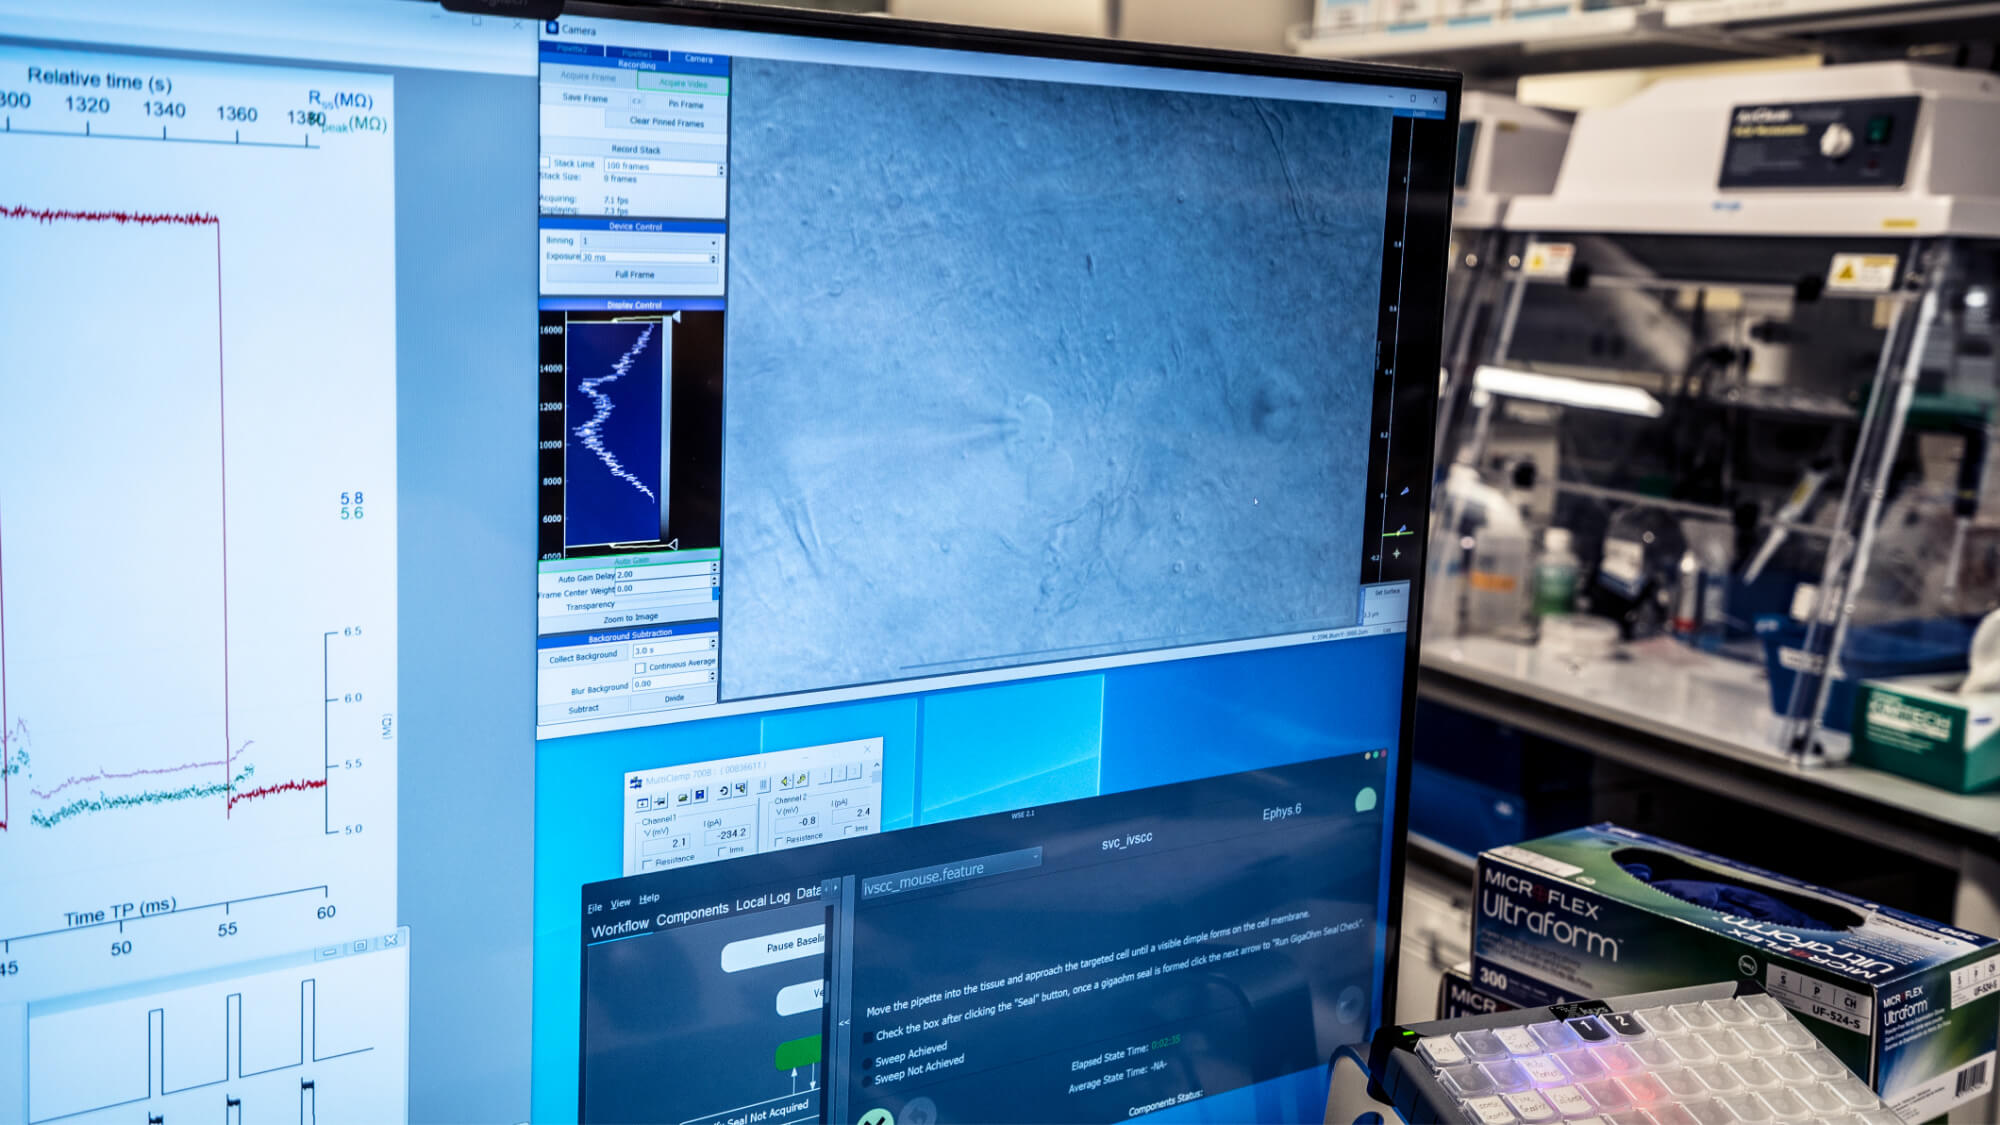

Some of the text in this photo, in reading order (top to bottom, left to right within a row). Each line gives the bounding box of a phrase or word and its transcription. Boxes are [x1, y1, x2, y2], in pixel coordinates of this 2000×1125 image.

[562, 24, 597, 37] Camera
[618, 60, 656, 70] Recording
[685, 54, 713, 64] Camera
[28, 66, 172, 95] Relative time (s)
[563, 92, 608, 104] Save Frame
[680, 100, 704, 109] Frame
[65, 95, 258, 122] 1320 1340 1360
[630, 115, 704, 129] Clear Pinned Frames
[611, 144, 661, 155] Record Stack
[554, 159, 649, 171] Stack frames
[610, 175, 637, 184] frames
[609, 222, 662, 231] Device Control
[546, 236, 574, 246] Binning
[546, 252, 580, 263] Exposure
[615, 270, 655, 279] Full Frame
[607, 300, 662, 310] Display Control
[539, 325, 563, 335] 16000
[539, 364, 563, 373] 14000
[539, 402, 563, 411] 12000
[539, 440, 562, 449] 10000
[543, 476, 562, 486] 8000
[340, 491, 364, 506] 5.8
[340, 506, 364, 520] 5.6
[542, 514, 562, 523] 6000
[632, 556, 650, 564] Gain
[558, 570, 633, 583] Auto Gain Delay 2.00
[564, 584, 633, 599] Center Weight 0.00
[566, 600, 616, 612] Transparency
[603, 611, 659, 624] Zoom Image
[344, 625, 362, 637] 6.5
[588, 628, 673, 644] Background Subtraction
[549, 650, 618, 664] Collect Background
[649, 657, 716, 671] Continuous Average
[571, 682, 629, 696] Blur Background
[344, 692, 363, 703] 6.0
[568, 693, 685, 715] Subtract Divide
[345, 757, 362, 769] 5.5
[857, 807, 870, 817] 2.4
[1263, 802, 1302, 822] Ephys.6
[798, 816, 816, 827] -0.8
[345, 824, 363, 836] 5.0
[717, 828, 746, 841] -234.2
[672, 837, 686, 848] 2.1
[786, 831, 823, 844] Resistance
[1102, 831, 1153, 850] svc_ivscc
[655, 854, 695, 867] Resistance
[863, 862, 984, 896] ivscc_mouse.feature
[588, 891, 660, 914] File View Help
[64, 896, 177, 928] Time TP (ms)
[591, 884, 822, 939] Workflow Components Local Log Data
[111, 905, 336, 956] 50 55 60
[1483, 889, 1618, 963] Ultraform
[767, 939, 794, 953] Pause
[867, 910, 1311, 1018] Move the pipette into the tissue and approach the targeted cell until visible dimple forms the cell membrane.
[876, 925, 1339, 1041] Check the box after clicking the "Seal" button, once gigaohm seal formed click the next arrow GigaOhm Seal
[1480, 966, 1508, 991] 300
[1781, 975, 1857, 1009] S P CH
[1812, 1005, 1860, 1029] UF-524-S
[1884, 1000, 1928, 1026] Ultraform
[1579, 1020, 1594, 1032] 1
[1615, 1015, 1629, 1027] 2
[875, 1040, 948, 1068] Sweep Achieved
[1071, 1034, 1181, 1071] Elapsed State Time: 0:02:35
[875, 1052, 965, 1086] Sweep Not Achieved
[1068, 1065, 1148, 1094] Average State Time:
[1128, 1089, 1204, 1117] Components Status:
[750, 1099, 809, 1123] Not Acquired
